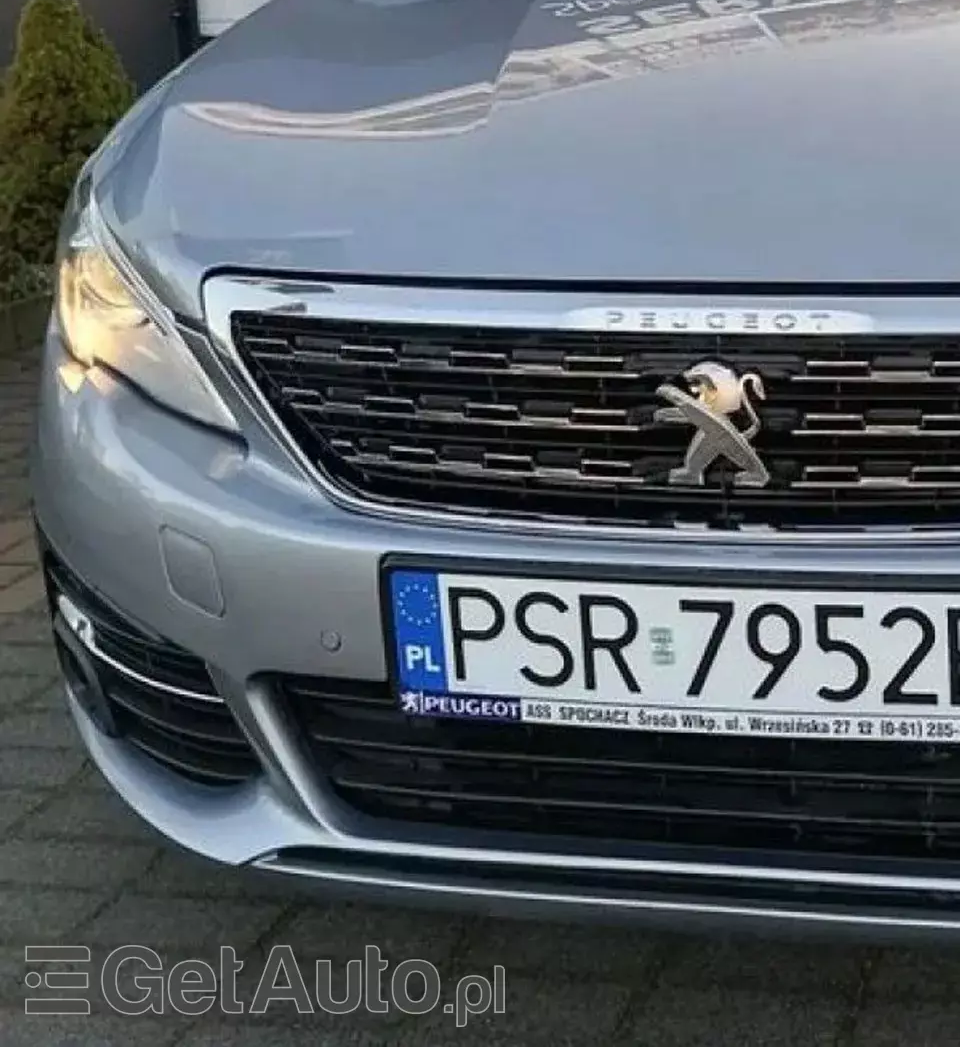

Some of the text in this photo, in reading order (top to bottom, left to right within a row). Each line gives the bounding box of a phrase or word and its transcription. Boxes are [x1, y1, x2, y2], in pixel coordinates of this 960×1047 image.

[607, 310, 831, 330] PEUGEOT
[448, 587, 641, 693] PSR
[405, 646, 441, 672] PL
[424, 696, 520, 718] PEUGEOT
[558, 706, 630, 726] SPOCHACZ
[637, 708, 678, 728] Środa
[833, 720, 850, 734] 27
